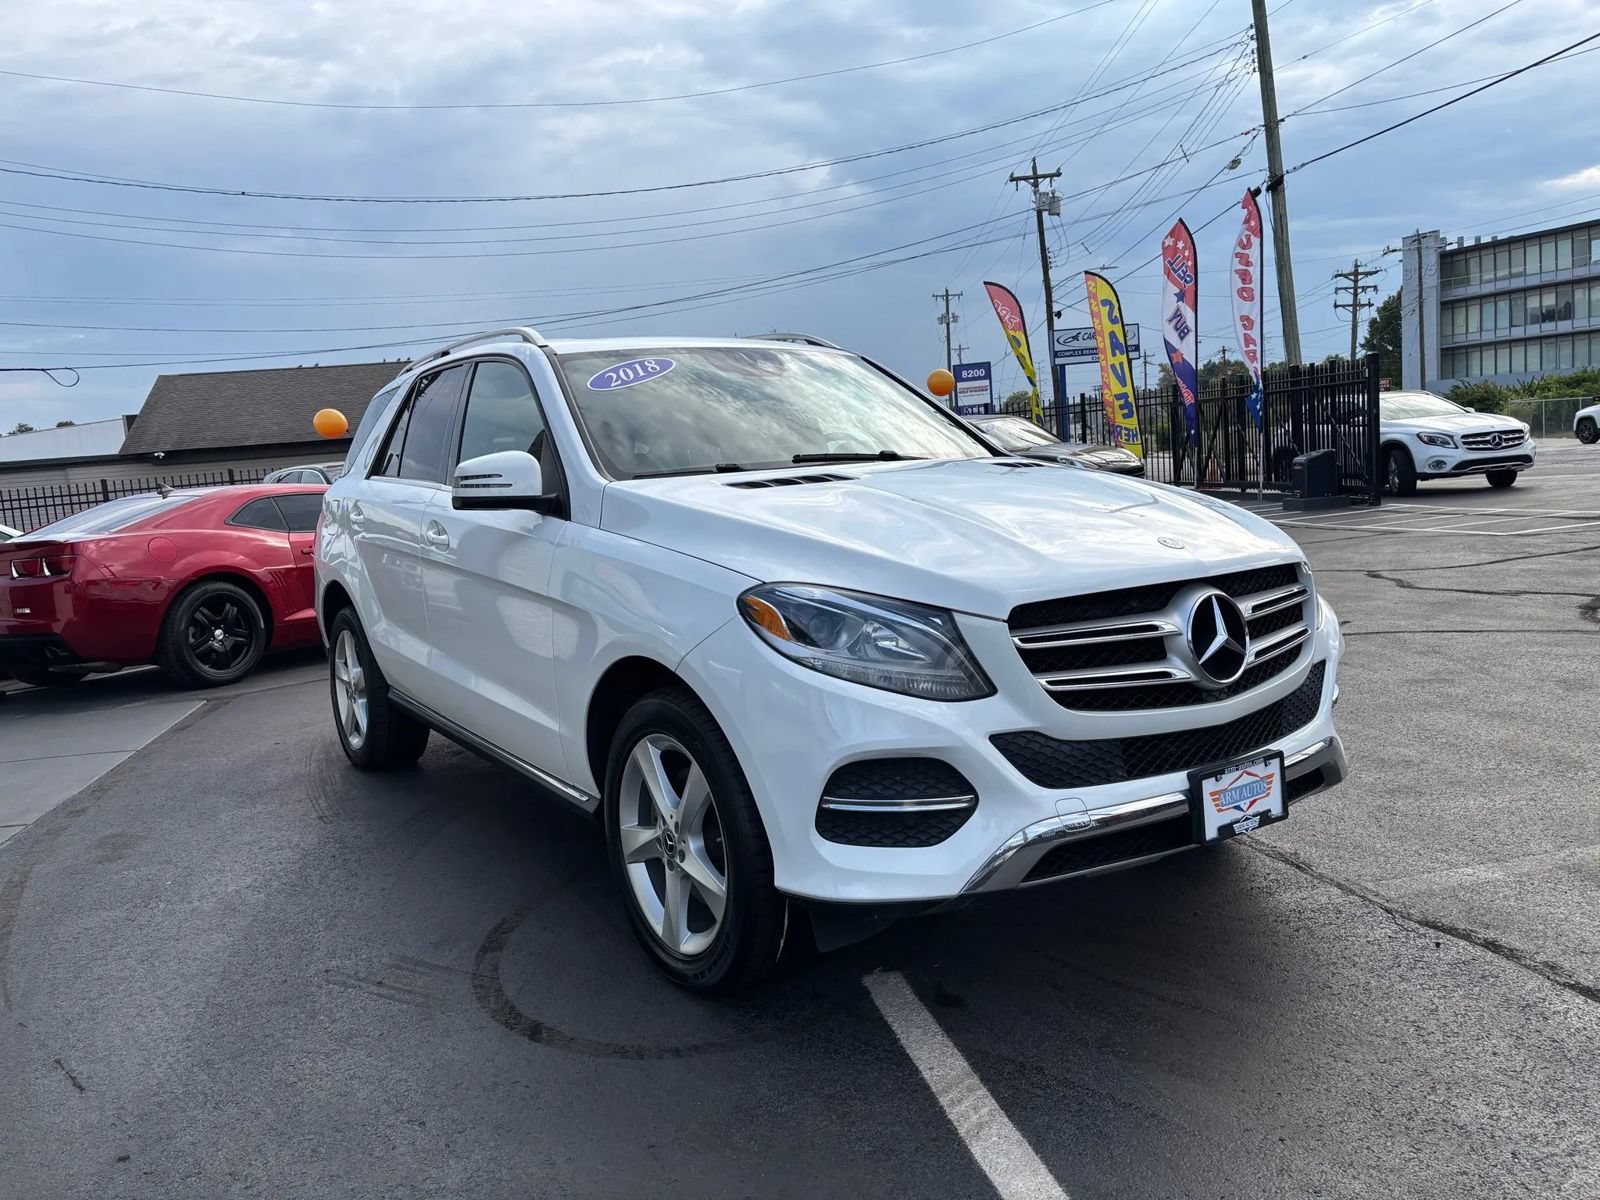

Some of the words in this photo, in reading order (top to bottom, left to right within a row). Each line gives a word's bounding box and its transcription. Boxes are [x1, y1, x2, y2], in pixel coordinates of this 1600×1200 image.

[605, 359, 660, 387] 2018
[962, 368, 985, 378] 8200
[1220, 790, 1240, 805] ARM
[1240, 780, 1267, 799] AUTOS
